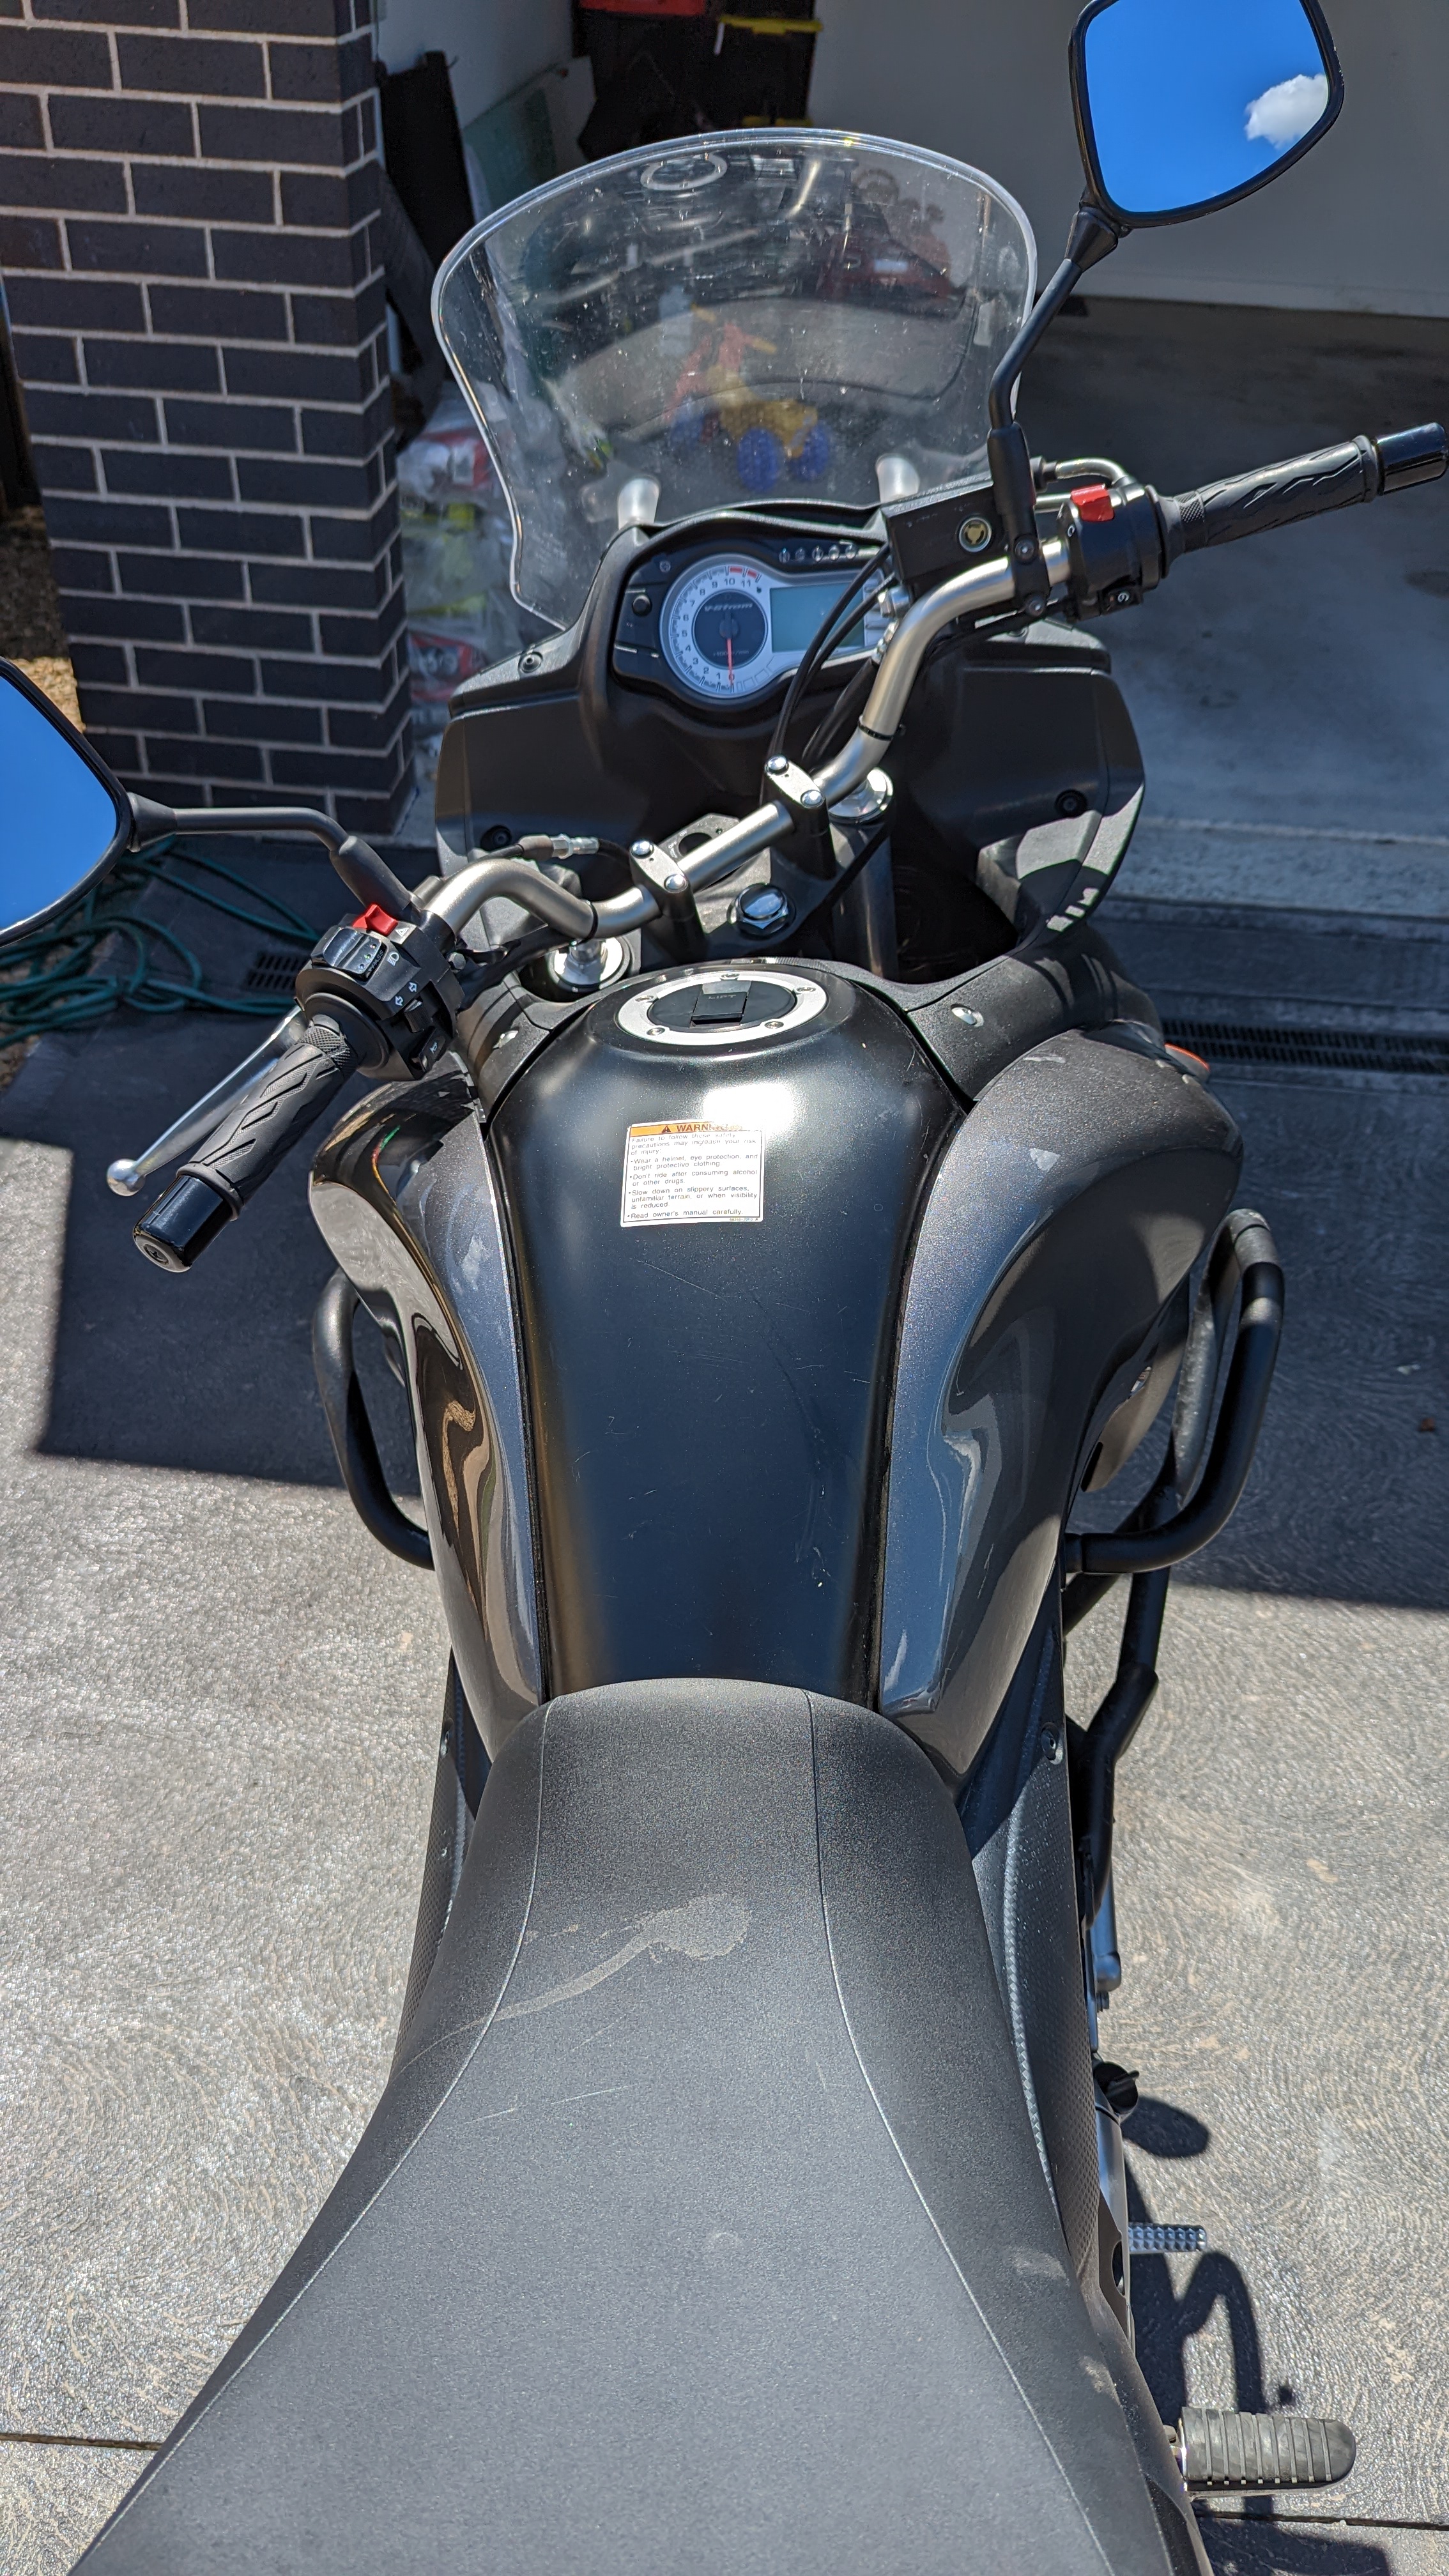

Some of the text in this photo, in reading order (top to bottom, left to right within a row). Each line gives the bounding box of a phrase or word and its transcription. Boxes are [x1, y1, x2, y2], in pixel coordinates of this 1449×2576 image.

[689, 599, 695, 608] 7
[371, 950, 384, 969] PASS
[631, 1141, 670, 1150] precautions
